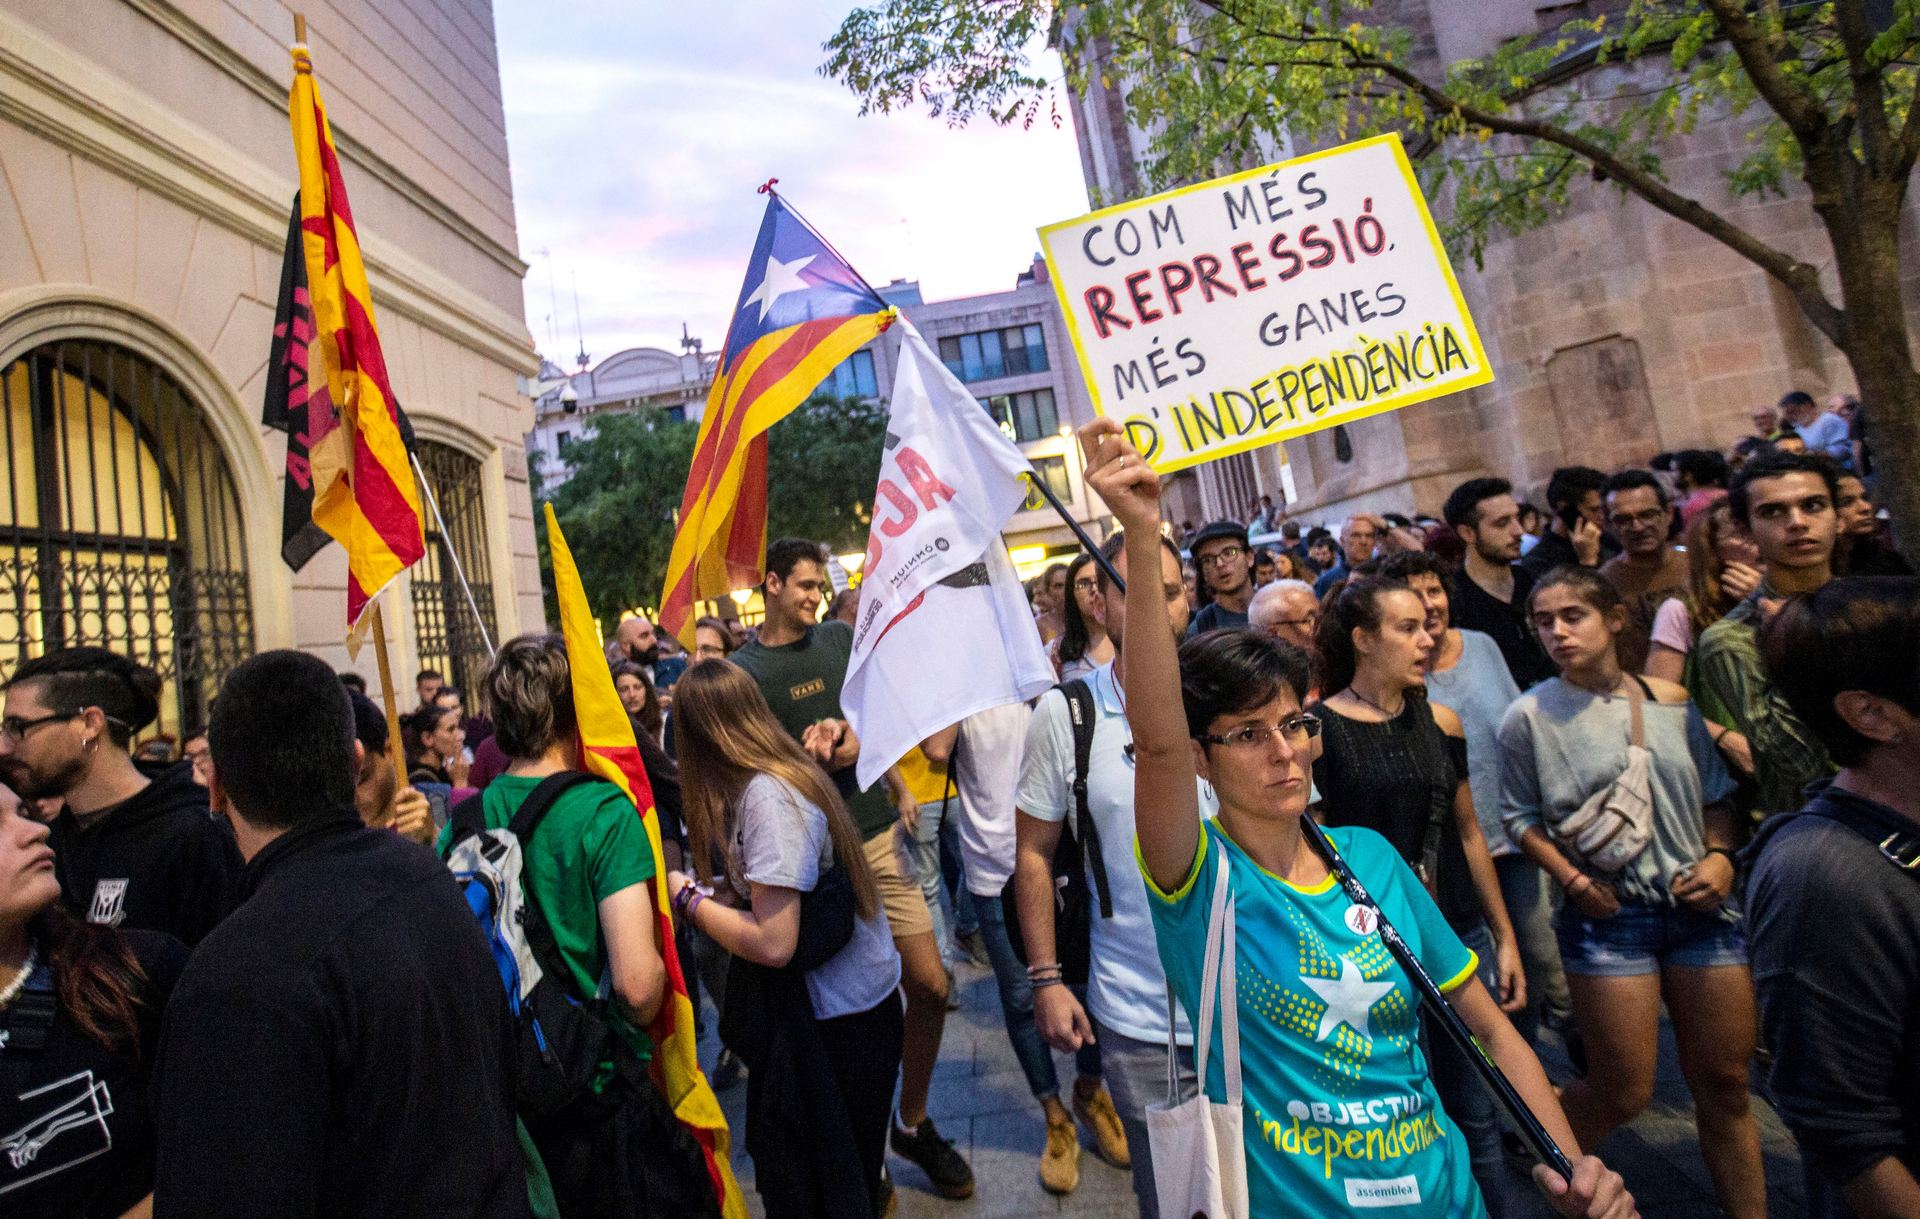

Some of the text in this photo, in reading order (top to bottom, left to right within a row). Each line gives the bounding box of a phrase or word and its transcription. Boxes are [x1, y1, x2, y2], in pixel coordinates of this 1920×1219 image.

[1083, 170, 1328, 267] COM MÉS
[1113, 283, 1406, 400] MÉS GANES
[1356, 1185, 1412, 1197] assemblea
